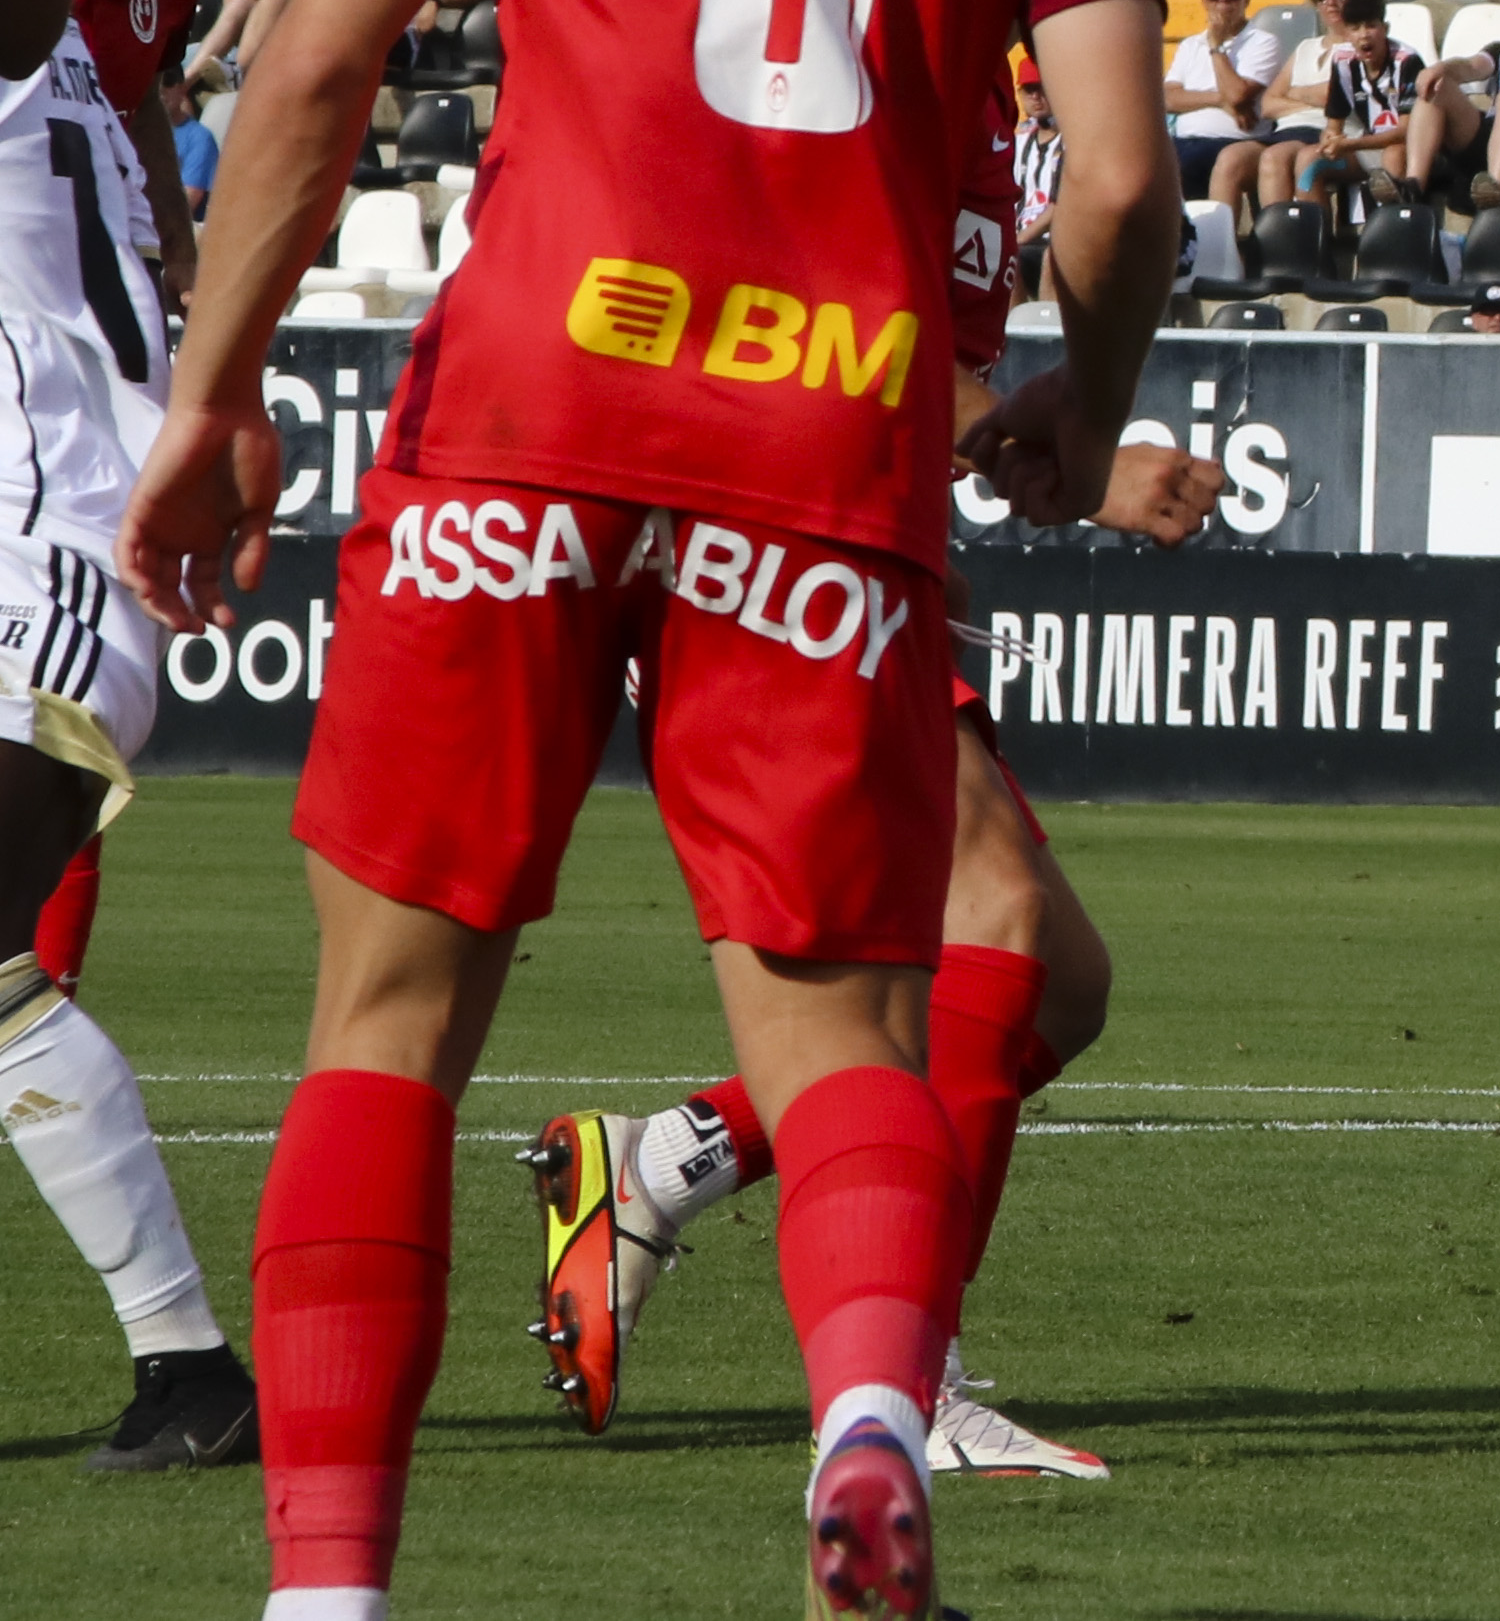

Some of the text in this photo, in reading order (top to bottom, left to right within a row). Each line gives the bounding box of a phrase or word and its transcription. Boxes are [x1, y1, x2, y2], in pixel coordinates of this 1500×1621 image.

[700, 284, 918, 408] BM
[380, 501, 908, 680] ASSA ABLOY
[990, 611, 1449, 732] PRIMERA RFEF
